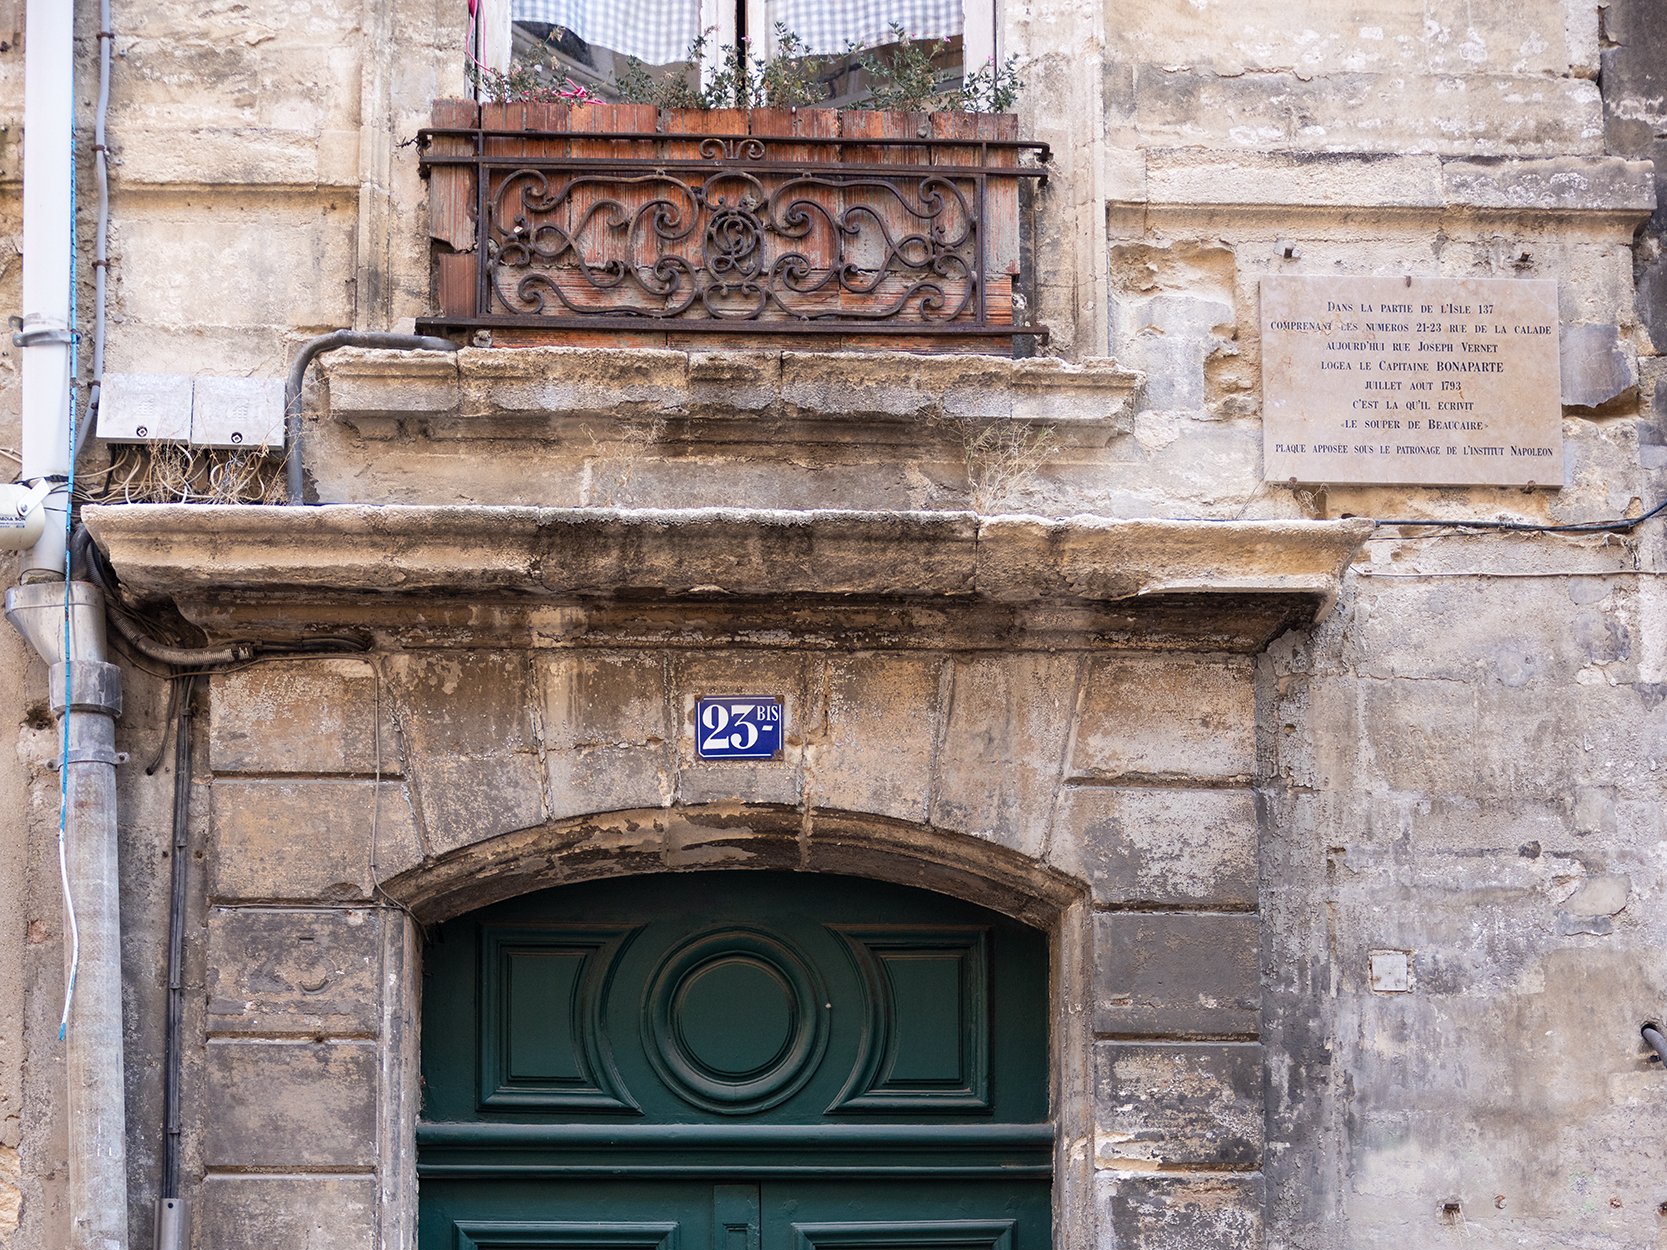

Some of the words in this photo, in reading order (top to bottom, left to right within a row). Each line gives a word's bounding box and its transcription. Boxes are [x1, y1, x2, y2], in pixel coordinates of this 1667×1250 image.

[1327, 301, 1354, 313] DANS
[1360, 303, 1373, 313] LA
[1380, 303, 1414, 314] PARTIE
[1420, 304, 1433, 314] DE
[1478, 304, 1494, 315] 137
[1270, 320, 1333, 332] COMPRENANT
[1340, 321, 1359, 332] LES
[1365, 322, 1409, 332] NUMEROS
[1416, 322, 1442, 333] 21-23
[1449, 324, 1468, 334] RUE
[1474, 324, 1488, 334] DE
[1494, 324, 1507, 334] LA
[1513, 325, 1552, 335] CALADE
[1325, 340, 1385, 352] AUJOURD'HUI
[1392, 342, 1411, 352] RUE
[1417, 341, 1454, 353] JOSEPH
[1461, 341, 1499, 353] VERNET
[1321, 360, 1352, 371] LOGEA
[1359, 361, 1372, 371] LE
[1378, 360, 1430, 372] CAPITAINE
[1436, 360, 1505, 373] BONAPARTE
[1364, 380, 1403, 391] JUILLET
[1409, 381, 1434, 391] AOUT
[1441, 380, 1463, 392] 1793
[1352, 398, 1379, 410] C'EST
[1386, 400, 1399, 410] LA
[1405, 399, 1431, 411] QU'IL
[1437, 401, 1475, 411] ECRIVIT
[1364, 419, 1401, 430] SOUPER
[1407, 420, 1421, 430] DE
[1275, 443, 1307, 454] PLAQUE
[1353, 444, 1374, 455] SOUS
[1379, 445, 1391, 455] LE
[1396, 445, 1441, 456] PATRONAGE
[1446, 445, 1458, 456] DE
[1463, 444, 1505, 456] L'INSTITUT
[1510, 445, 1553, 457] NAPOLEON
[702, 704, 758, 750] 23
[756, 705, 779, 721] BIS
